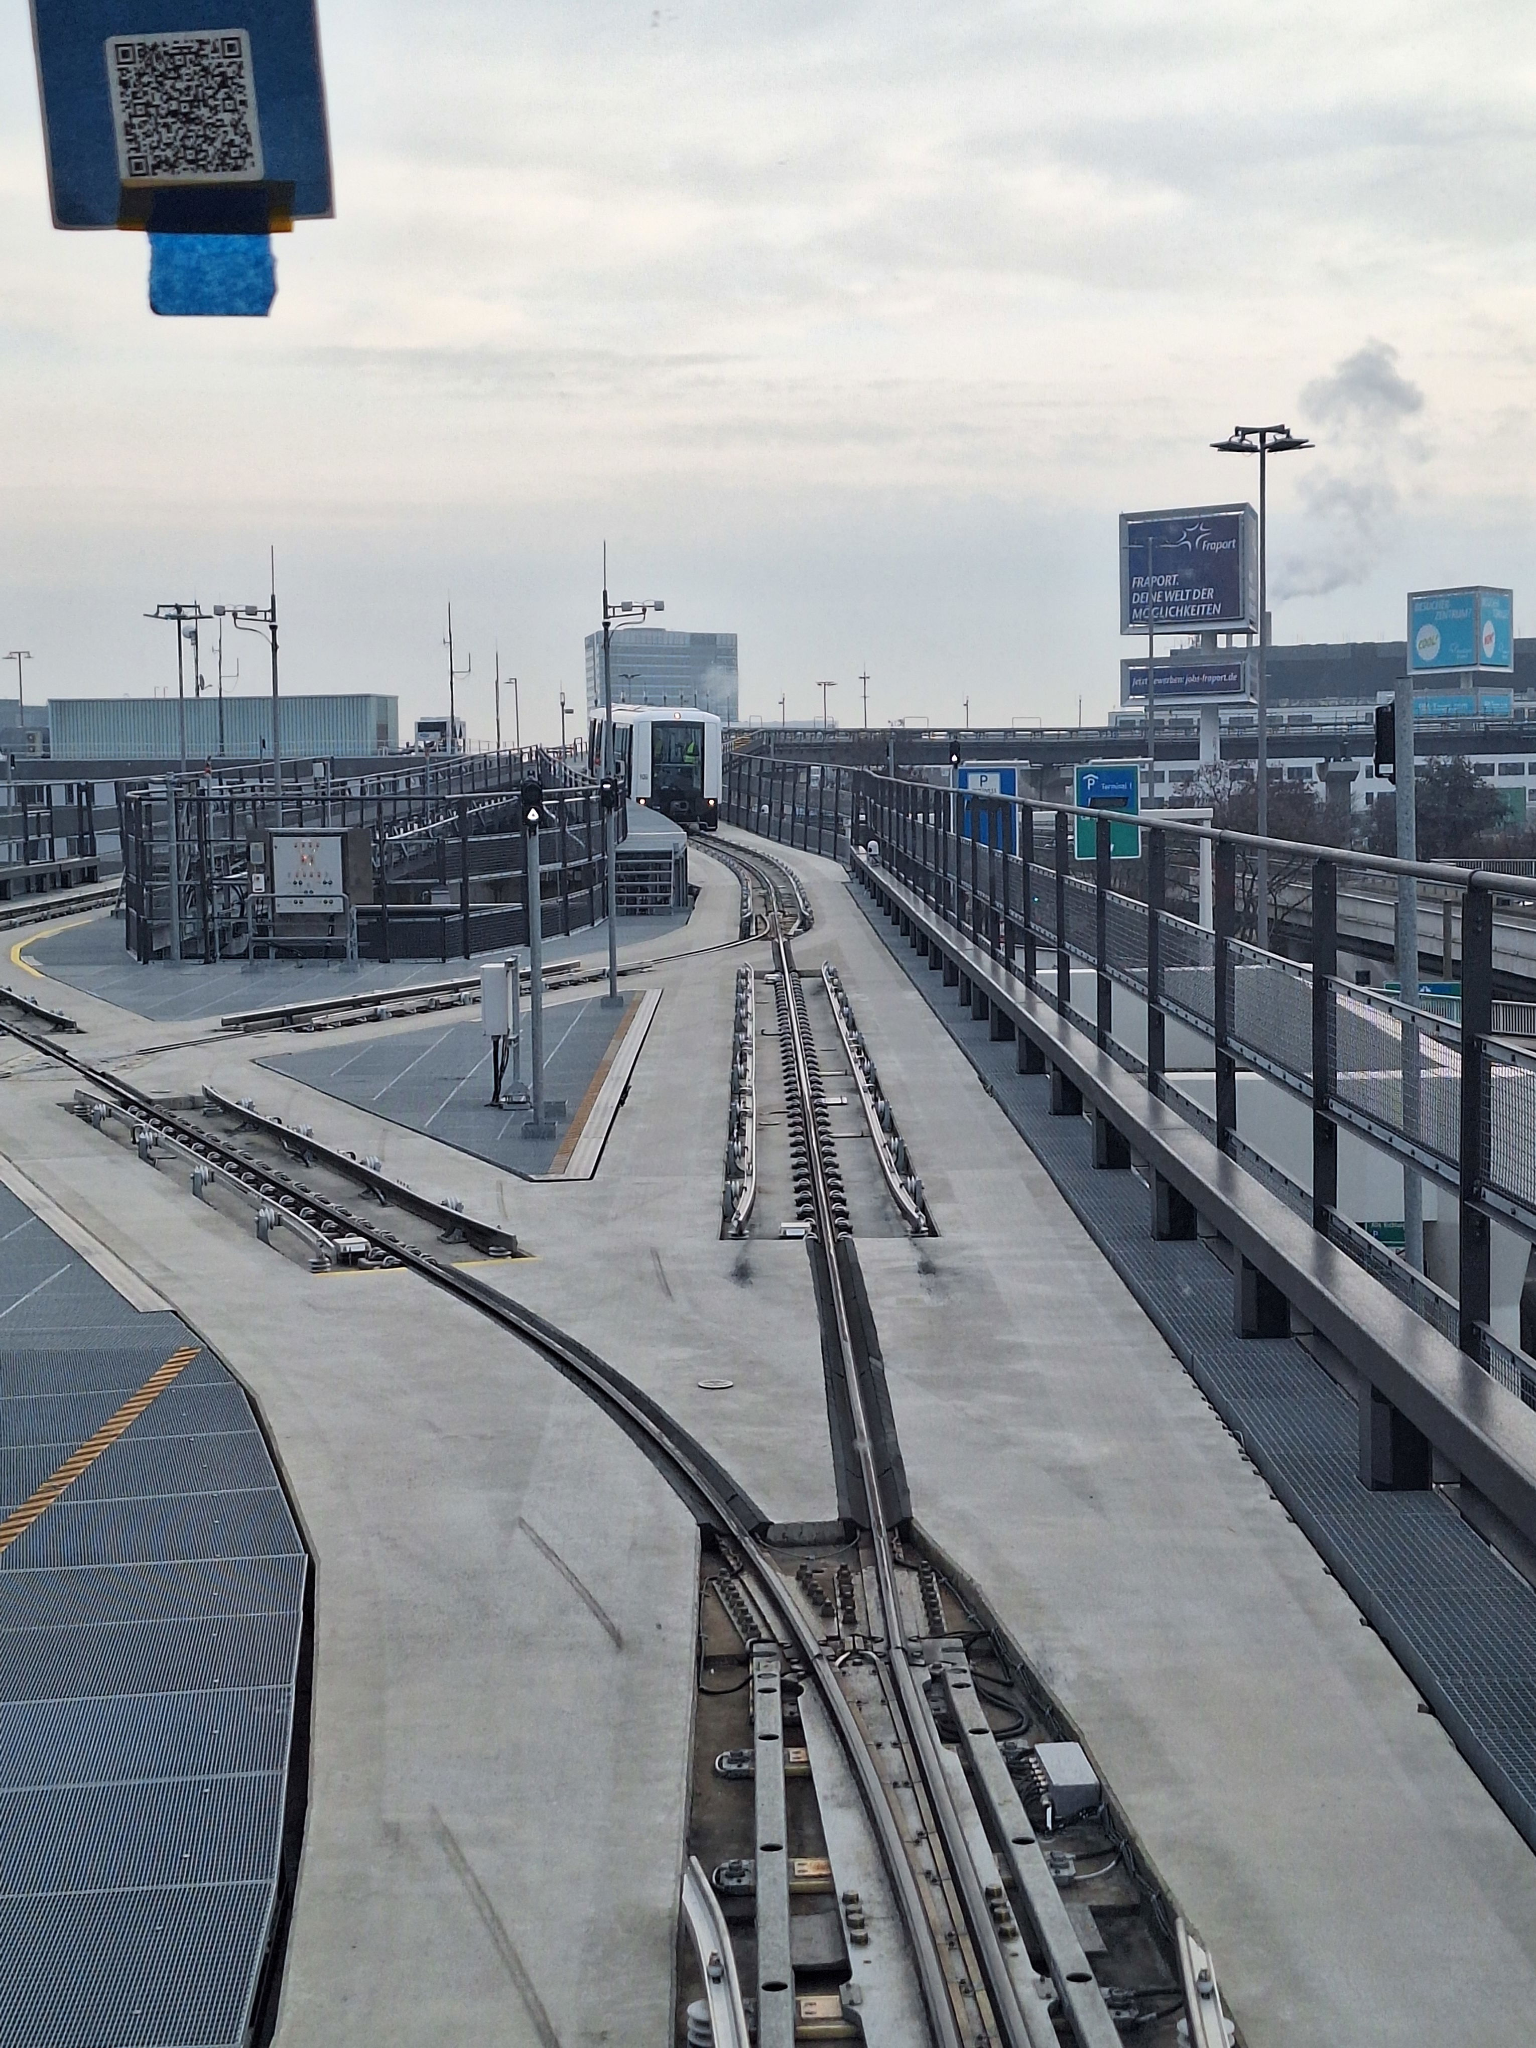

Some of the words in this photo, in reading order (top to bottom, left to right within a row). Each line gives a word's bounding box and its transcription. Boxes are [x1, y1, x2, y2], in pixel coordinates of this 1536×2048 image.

[1202, 539, 1236, 553] Fraport
[1132, 574, 1179, 588] FRAPORT.
[1165, 589, 1192, 602] WELT
[1192, 587, 1214, 600] DER
[980, 774, 988, 787] P
[1087, 778, 1095, 790] P
[1101, 782, 1127, 790] Terminal
